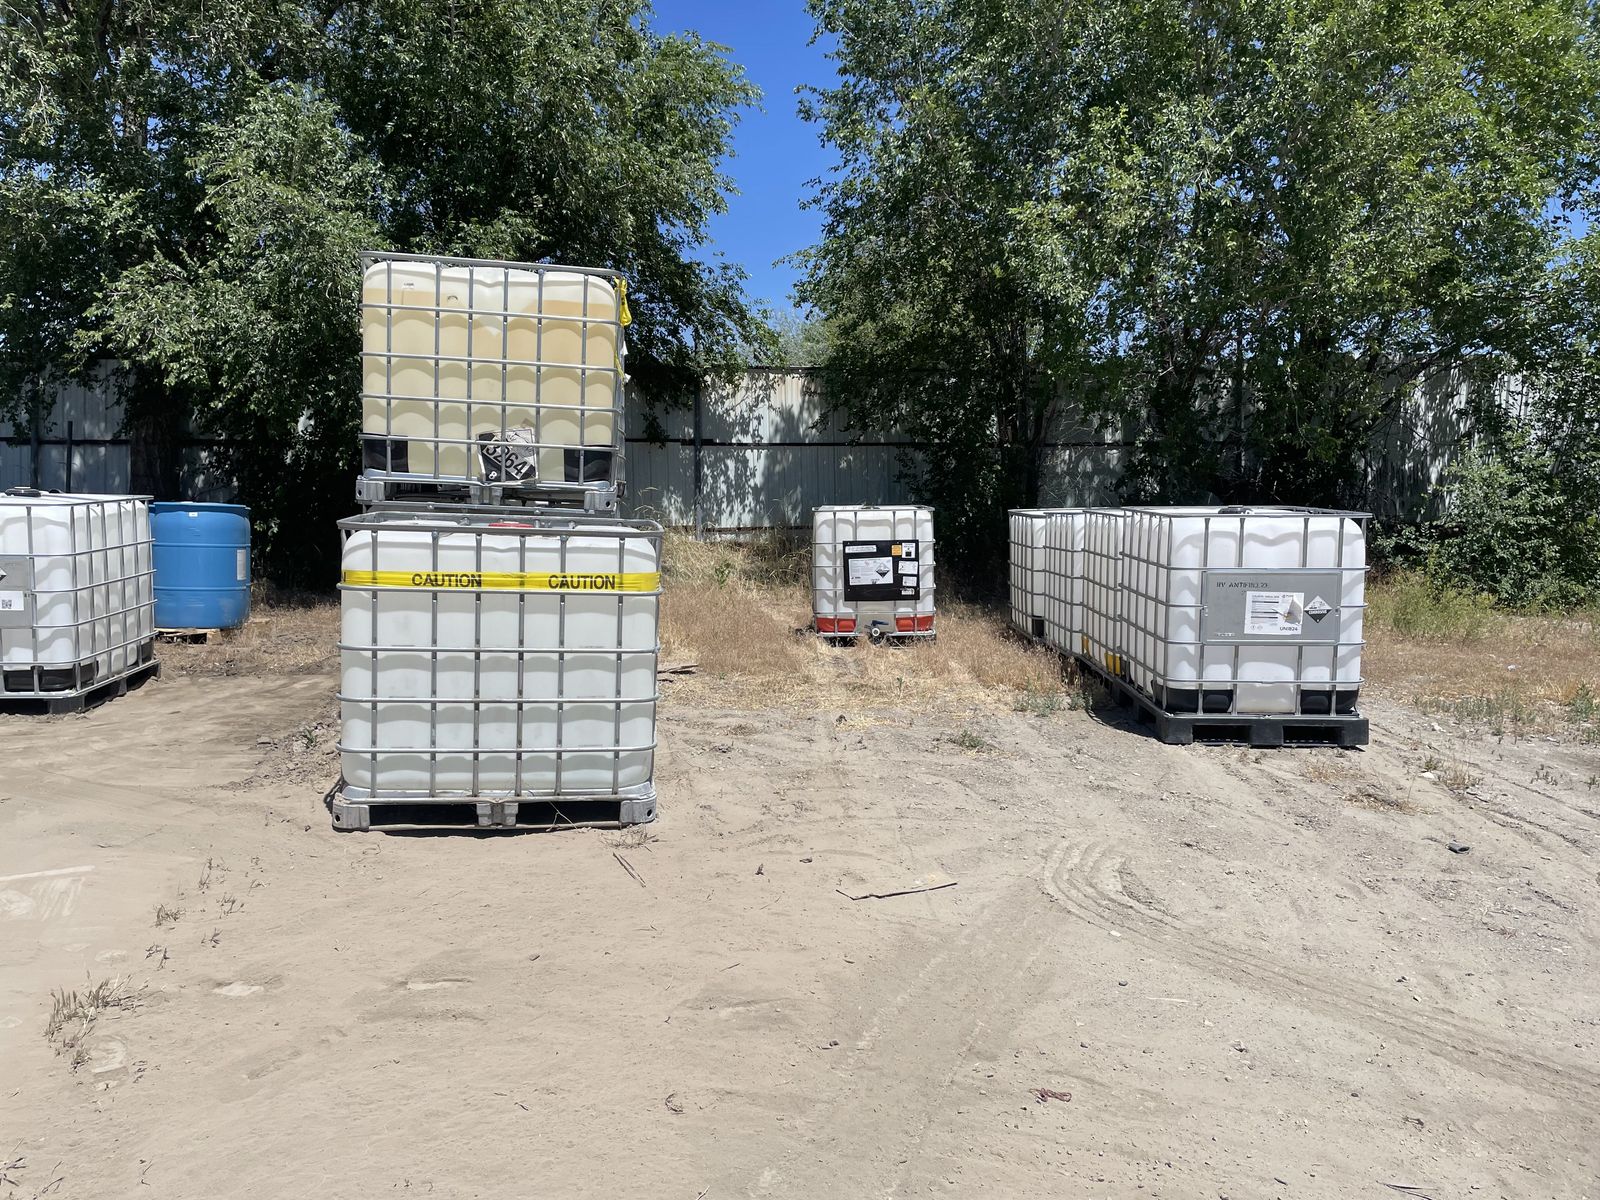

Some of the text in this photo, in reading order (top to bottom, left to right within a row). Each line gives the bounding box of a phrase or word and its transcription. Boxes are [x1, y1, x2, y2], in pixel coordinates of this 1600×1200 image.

[488, 471, 498, 480] 8
[411, 573, 616, 590] CAUTION CAUTION
